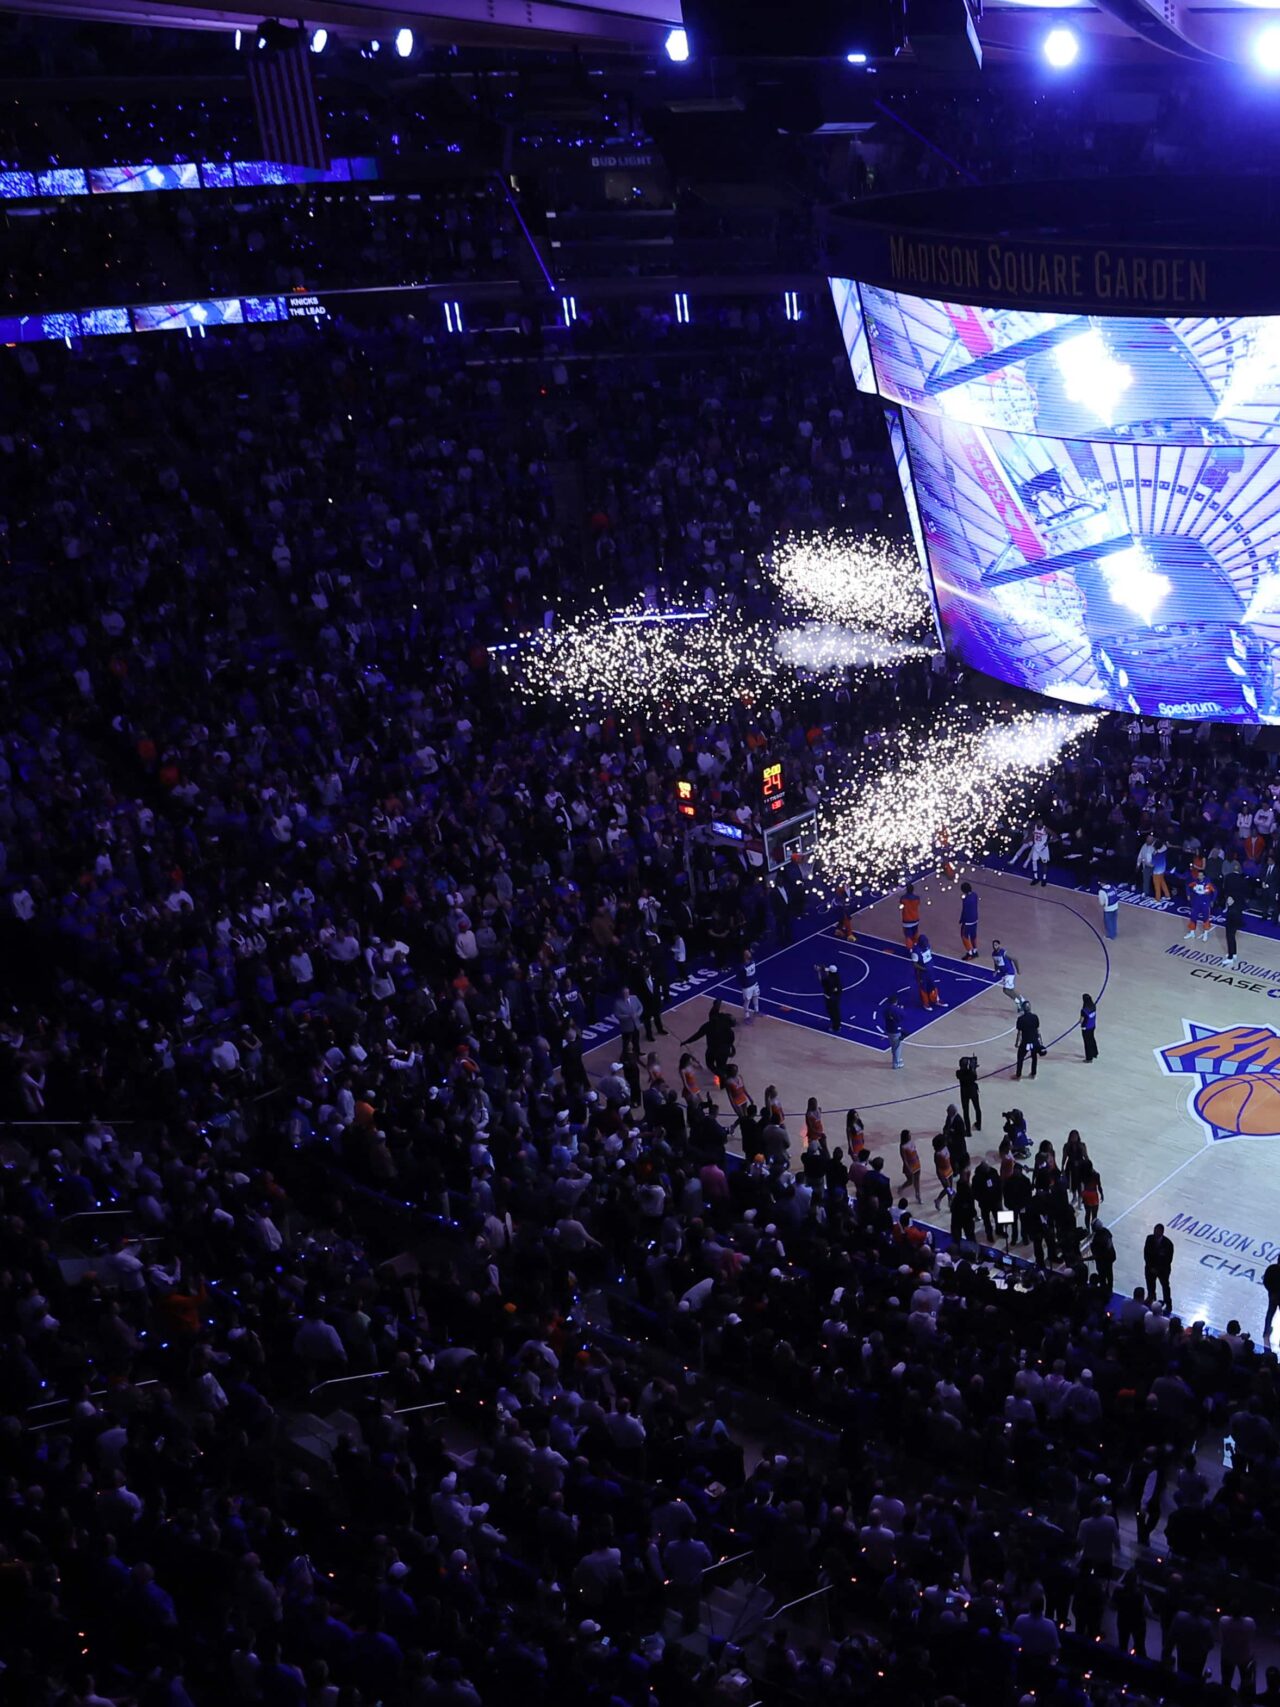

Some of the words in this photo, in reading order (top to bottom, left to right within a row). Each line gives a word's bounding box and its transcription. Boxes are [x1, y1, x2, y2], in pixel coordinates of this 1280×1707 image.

[591, 157, 617, 167] BUD
[890, 235, 980, 288] MADISON
[988, 244, 1084, 296] SQUARE
[1094, 250, 1207, 301] GARDEN
[290, 297, 318, 306] KNICKS
[289, 308, 305, 316] THE
[306, 306, 326, 315] LEAD
[1158, 701, 1218, 717] Spectrum
[763, 774, 781, 795] 24
[1190, 968, 1266, 993] CHASE
[1166, 1212, 1254, 1253] MADISON
